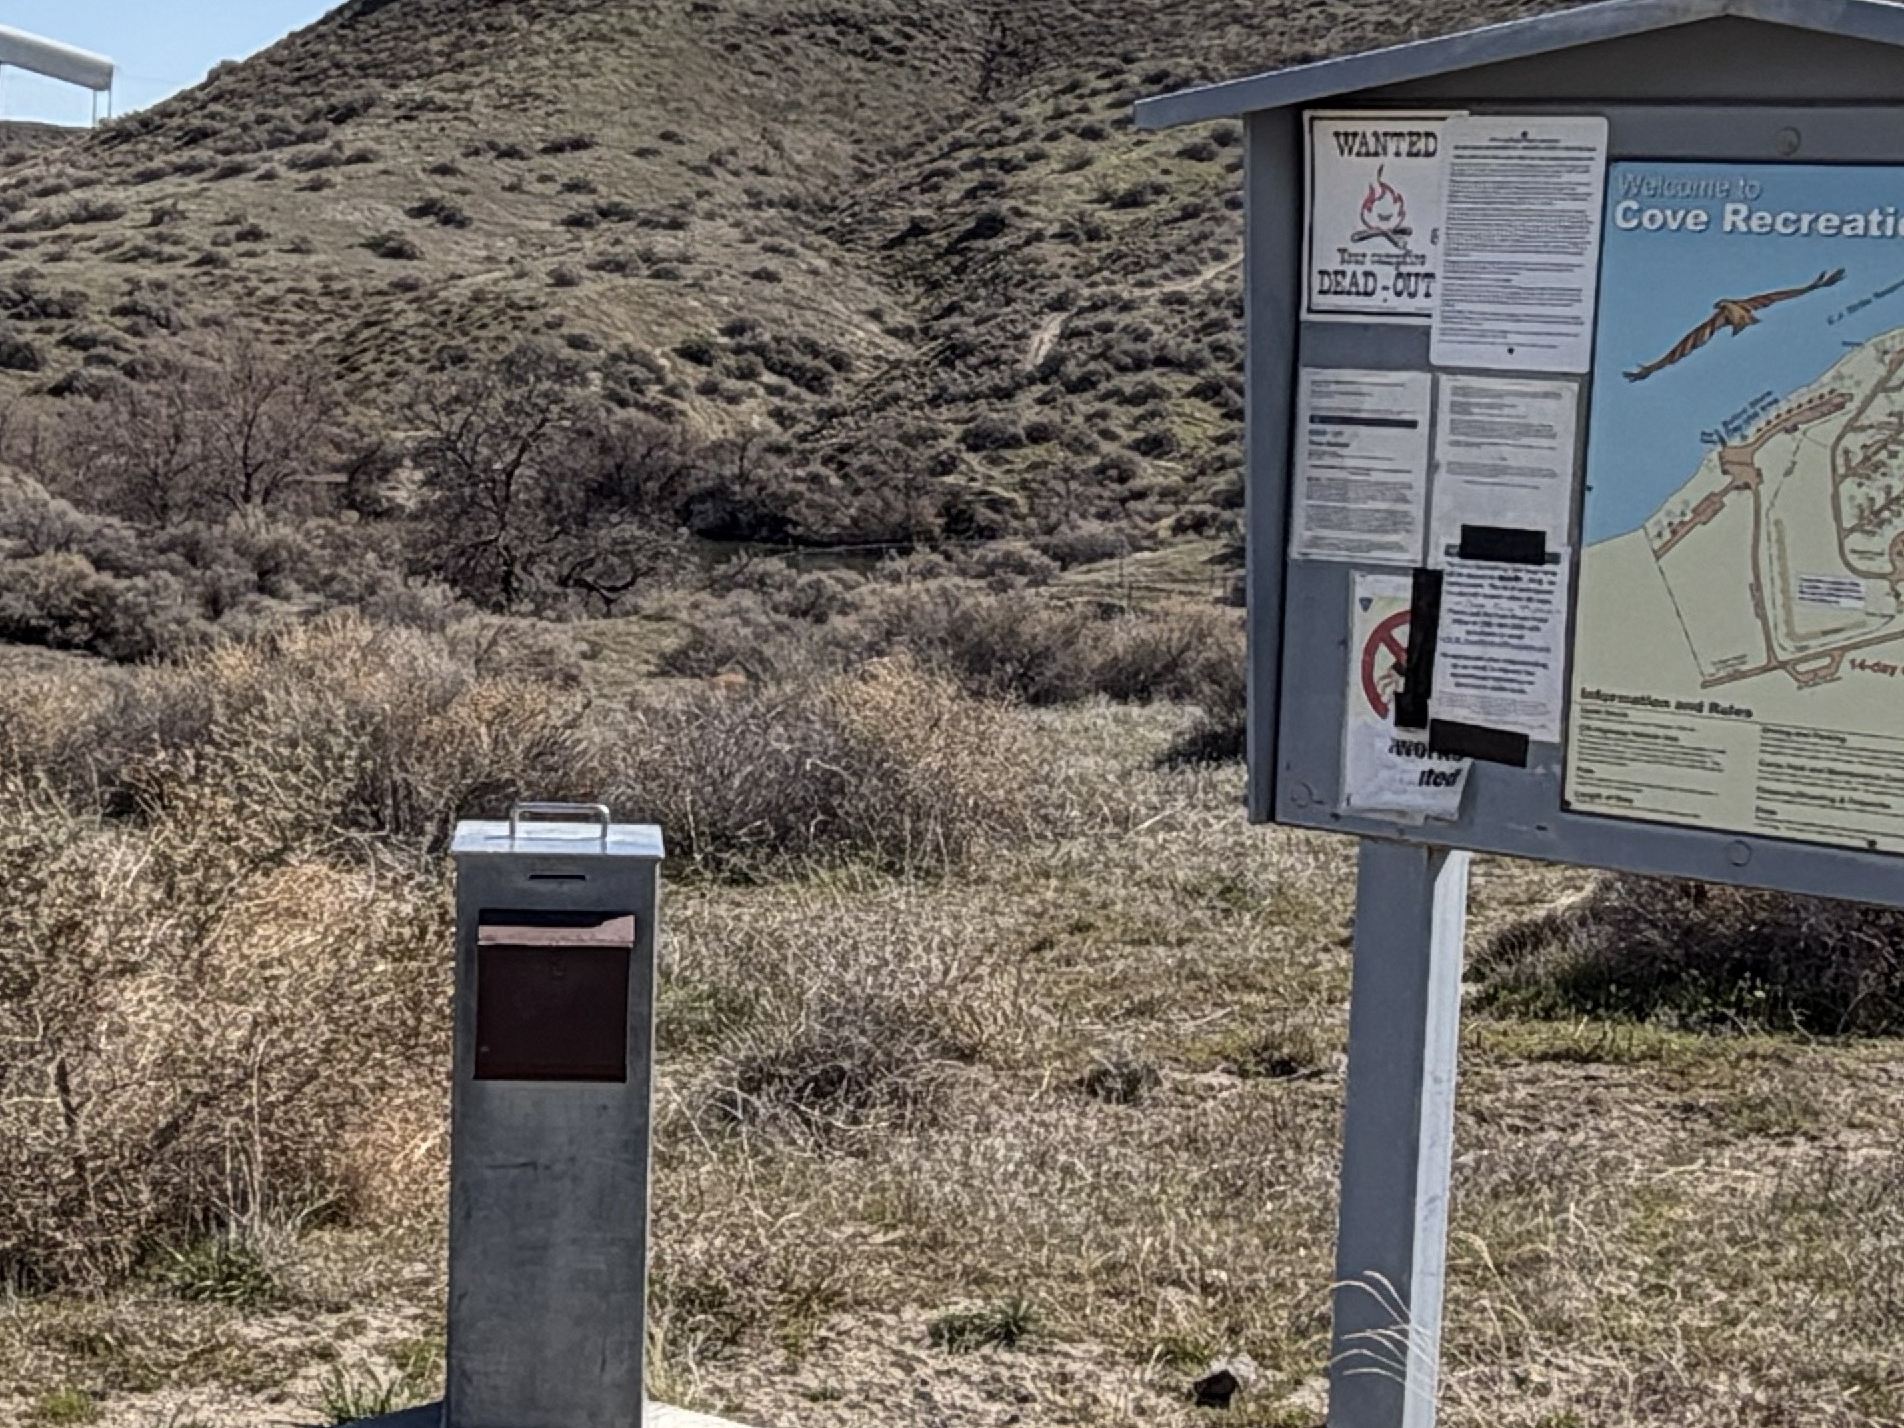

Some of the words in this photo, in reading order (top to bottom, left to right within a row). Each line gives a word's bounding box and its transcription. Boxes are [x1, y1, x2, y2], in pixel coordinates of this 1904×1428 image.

[1333, 130, 1439, 158] WANTED
[1616, 173, 1730, 200] Welcome
[1736, 177, 1762, 201] to
[1611, 201, 1711, 234] Cove
[1580, 686, 1671, 708] Information
[1674, 700, 1704, 713] and
[1708, 701, 1753, 718] Rules
